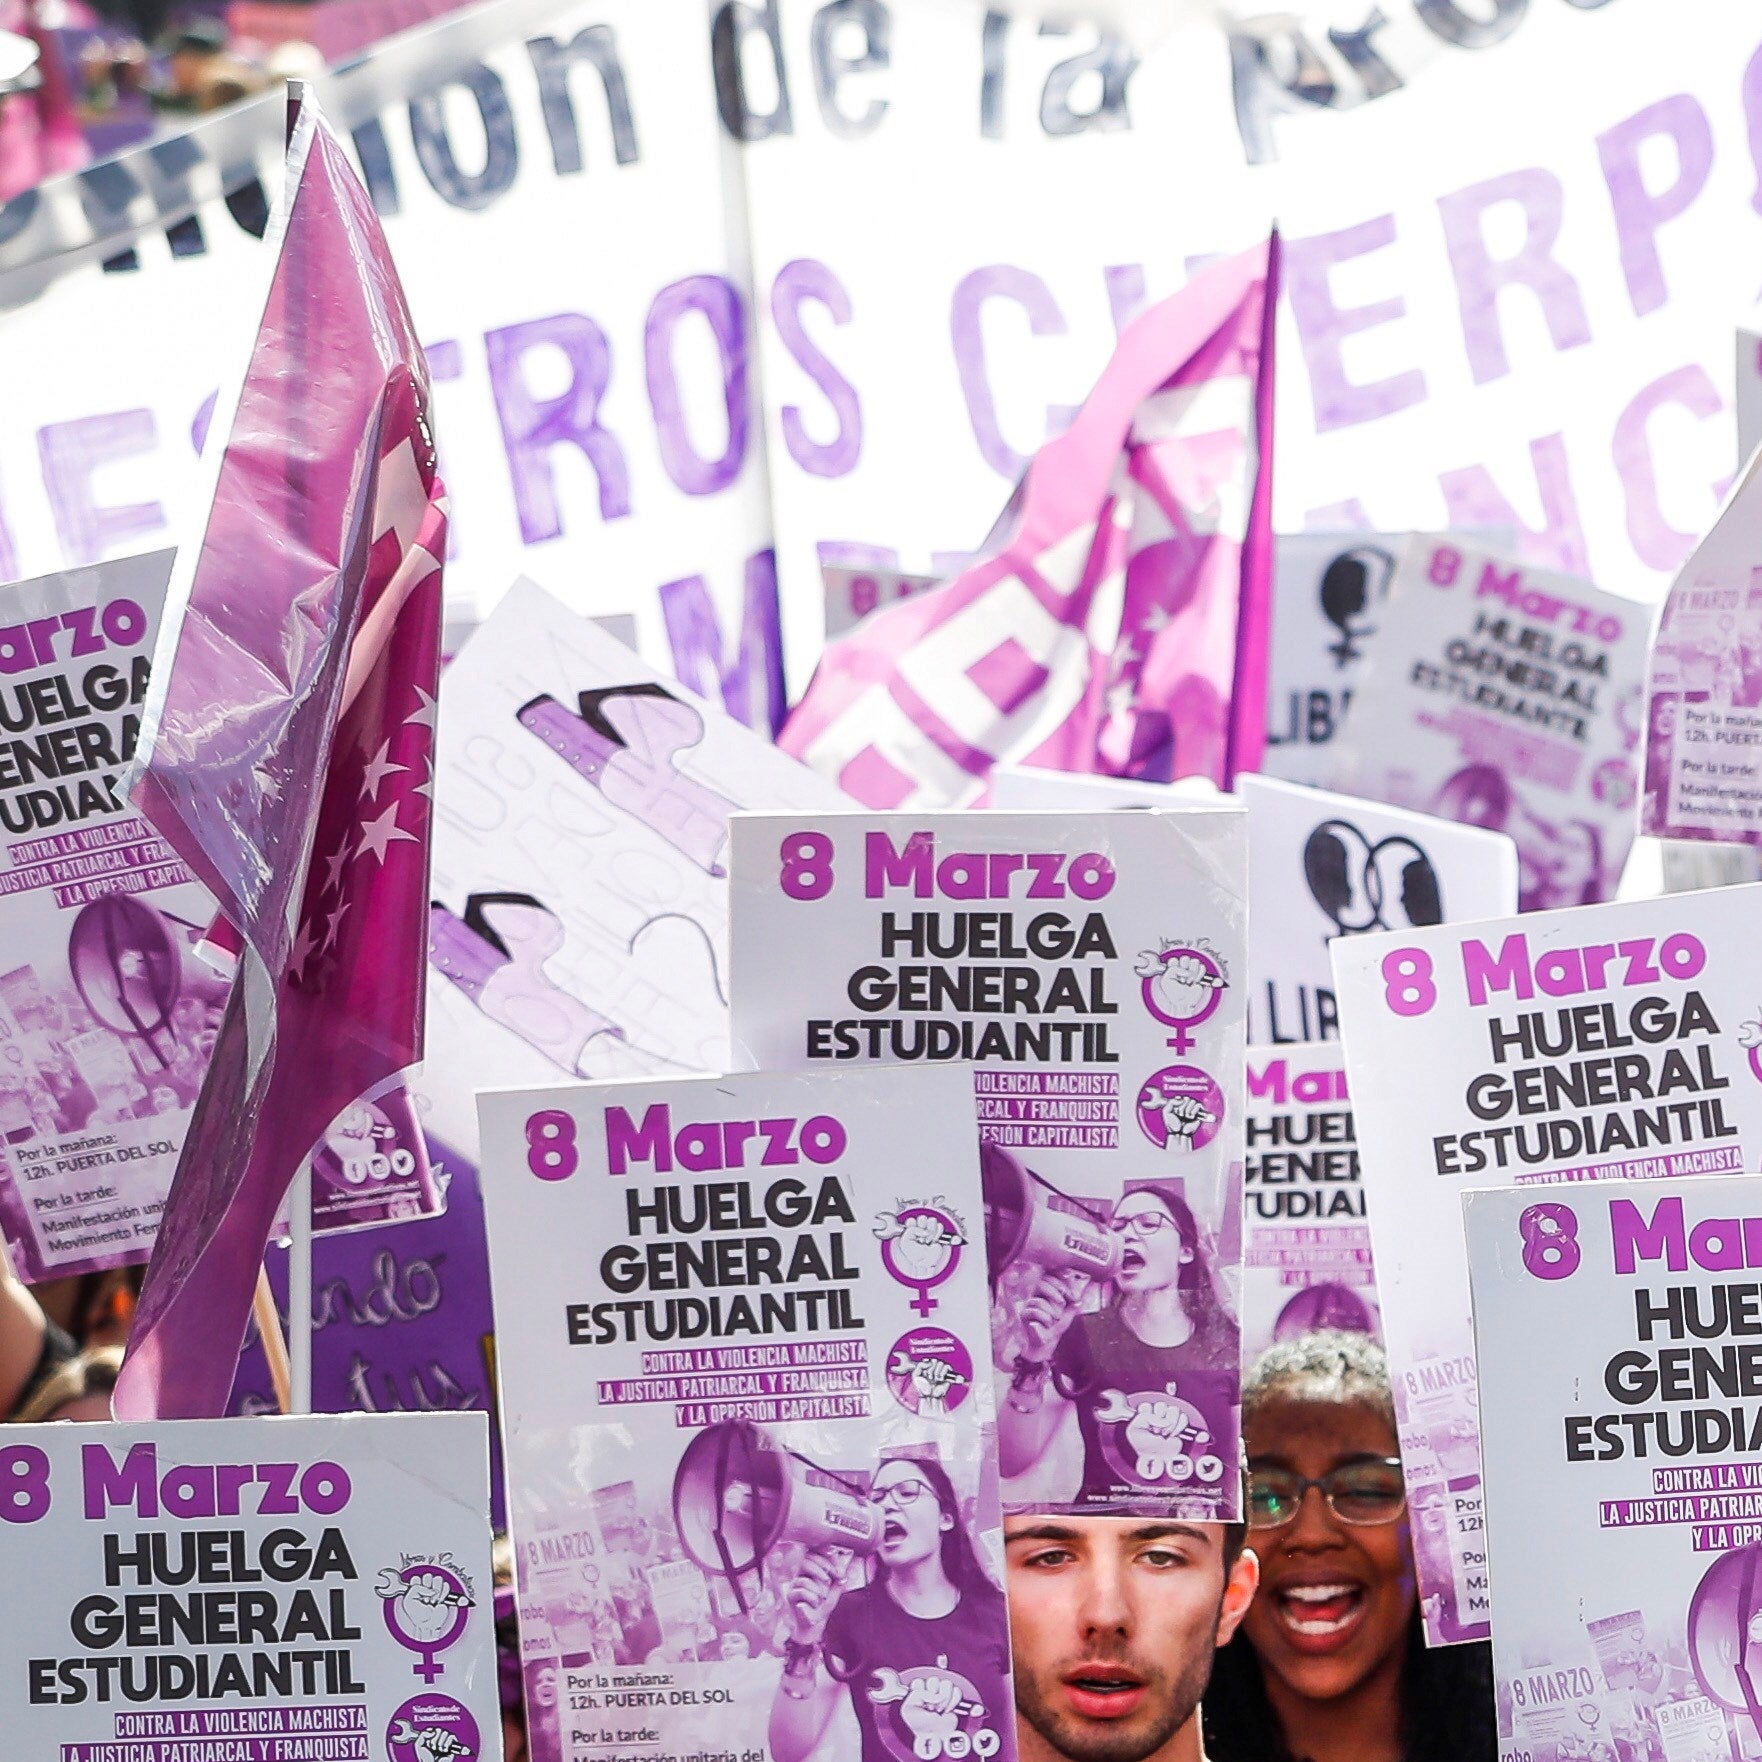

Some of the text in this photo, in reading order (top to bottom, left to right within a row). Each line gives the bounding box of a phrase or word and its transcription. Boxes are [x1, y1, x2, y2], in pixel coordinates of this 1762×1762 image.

[710, 0, 892, 143] de
[980, 8, 1137, 140] la
[1476, 561, 1624, 643] Marzo
[779, 828, 1116, 902] 8 Marzo
[881, 910, 1118, 961] HUELGA
[846, 963, 1119, 1014] GENERAL
[806, 1018, 1120, 1063] ESTUDIANTIL
[525, 1105, 847, 1184] 8 Marzo
[1518, 1199, 1582, 1281] 8
[0, 1441, 353, 1523] 8 Marzo
[102, 1527, 359, 1586] HUELGA
[68, 1588, 363, 1650] GENERAL
[27, 1650, 367, 1705] ESTUDIANTIL
